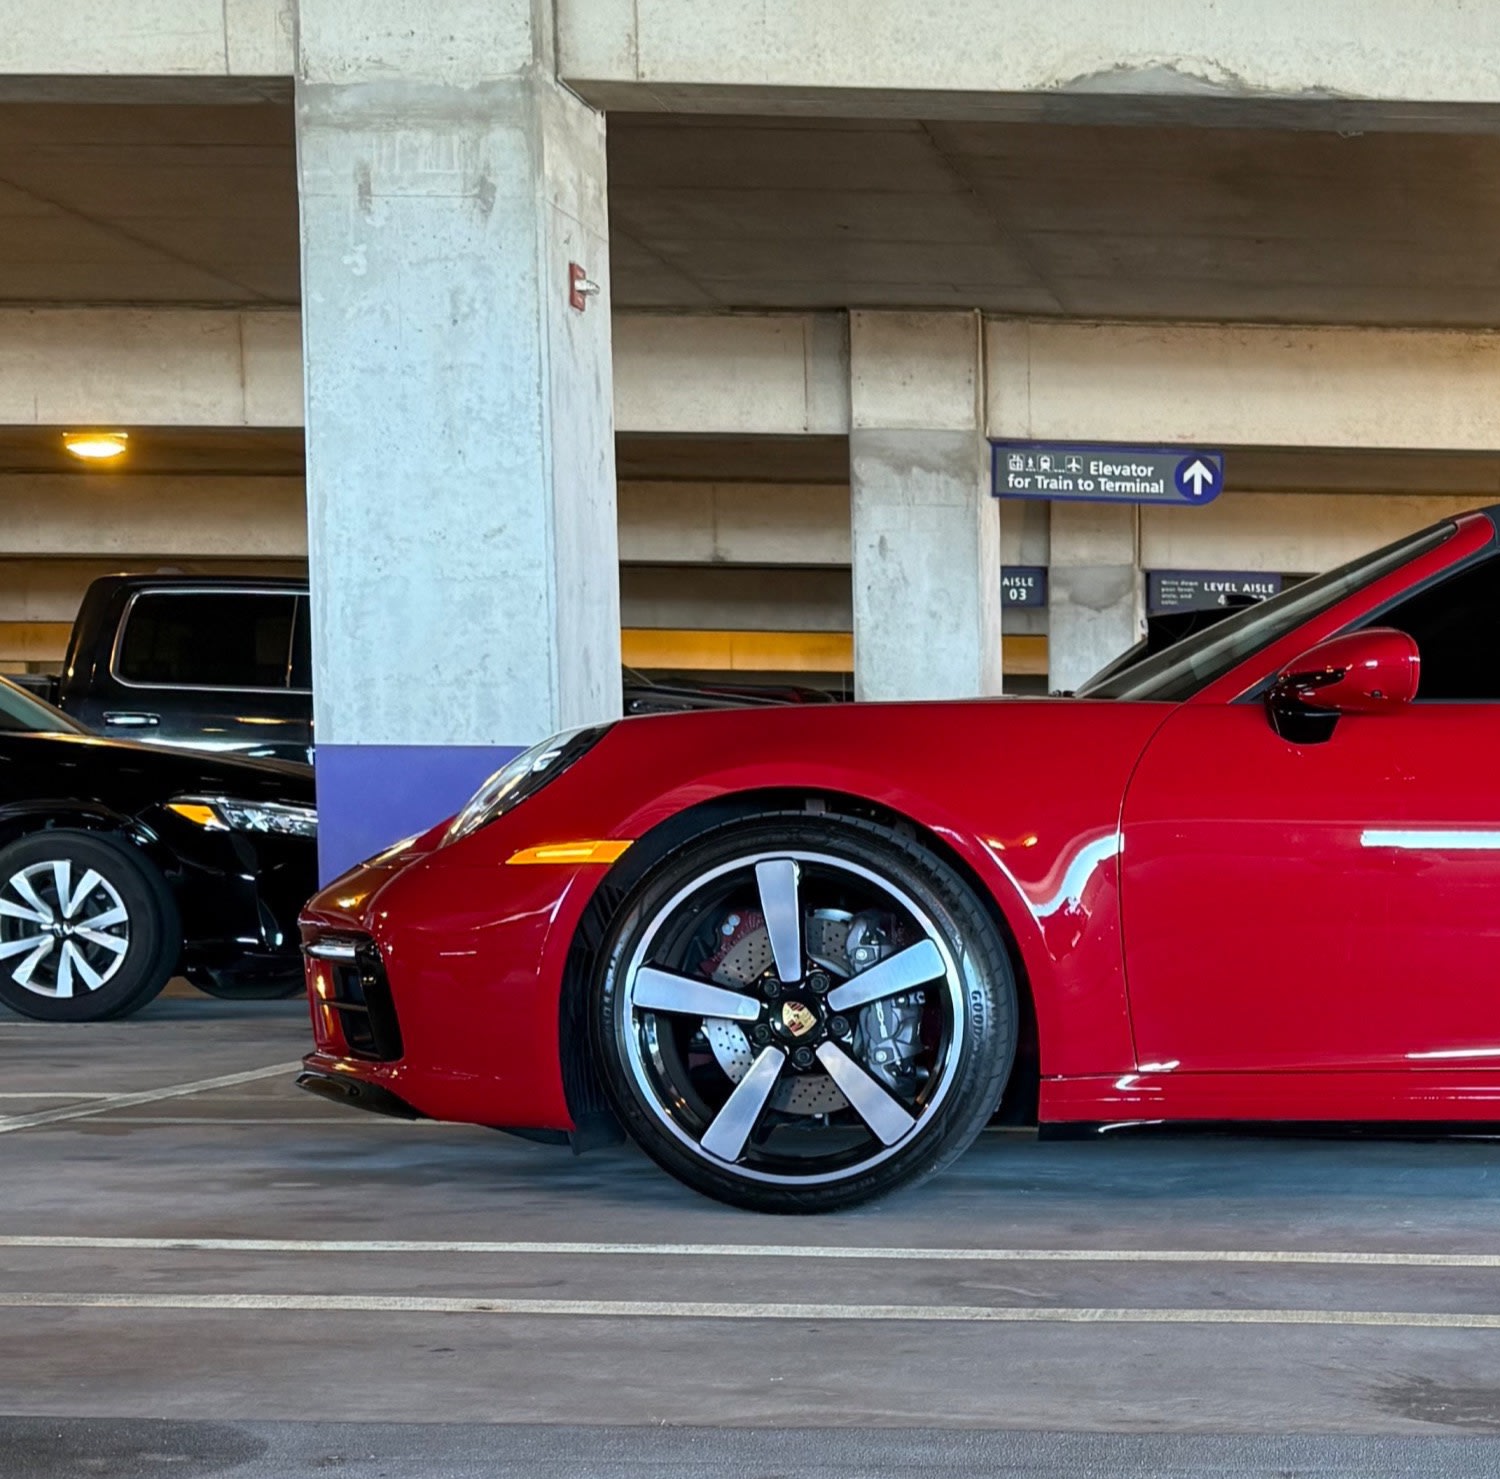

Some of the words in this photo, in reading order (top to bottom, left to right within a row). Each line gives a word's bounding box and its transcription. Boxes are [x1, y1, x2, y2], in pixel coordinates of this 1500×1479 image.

[1090, 461, 1154, 477] Elevator
[1008, 473, 1031, 488] for
[1035, 475, 1073, 490] Train
[1077, 478, 1094, 491] to
[1098, 478, 1164, 493] Terminal
[1002, 577, 1034, 587] AISLE
[1204, 582, 1238, 592] LEVEL
[1242, 583, 1274, 593] AISLE
[1009, 588, 1027, 601] 03
[1217, 594, 1226, 605] 4
